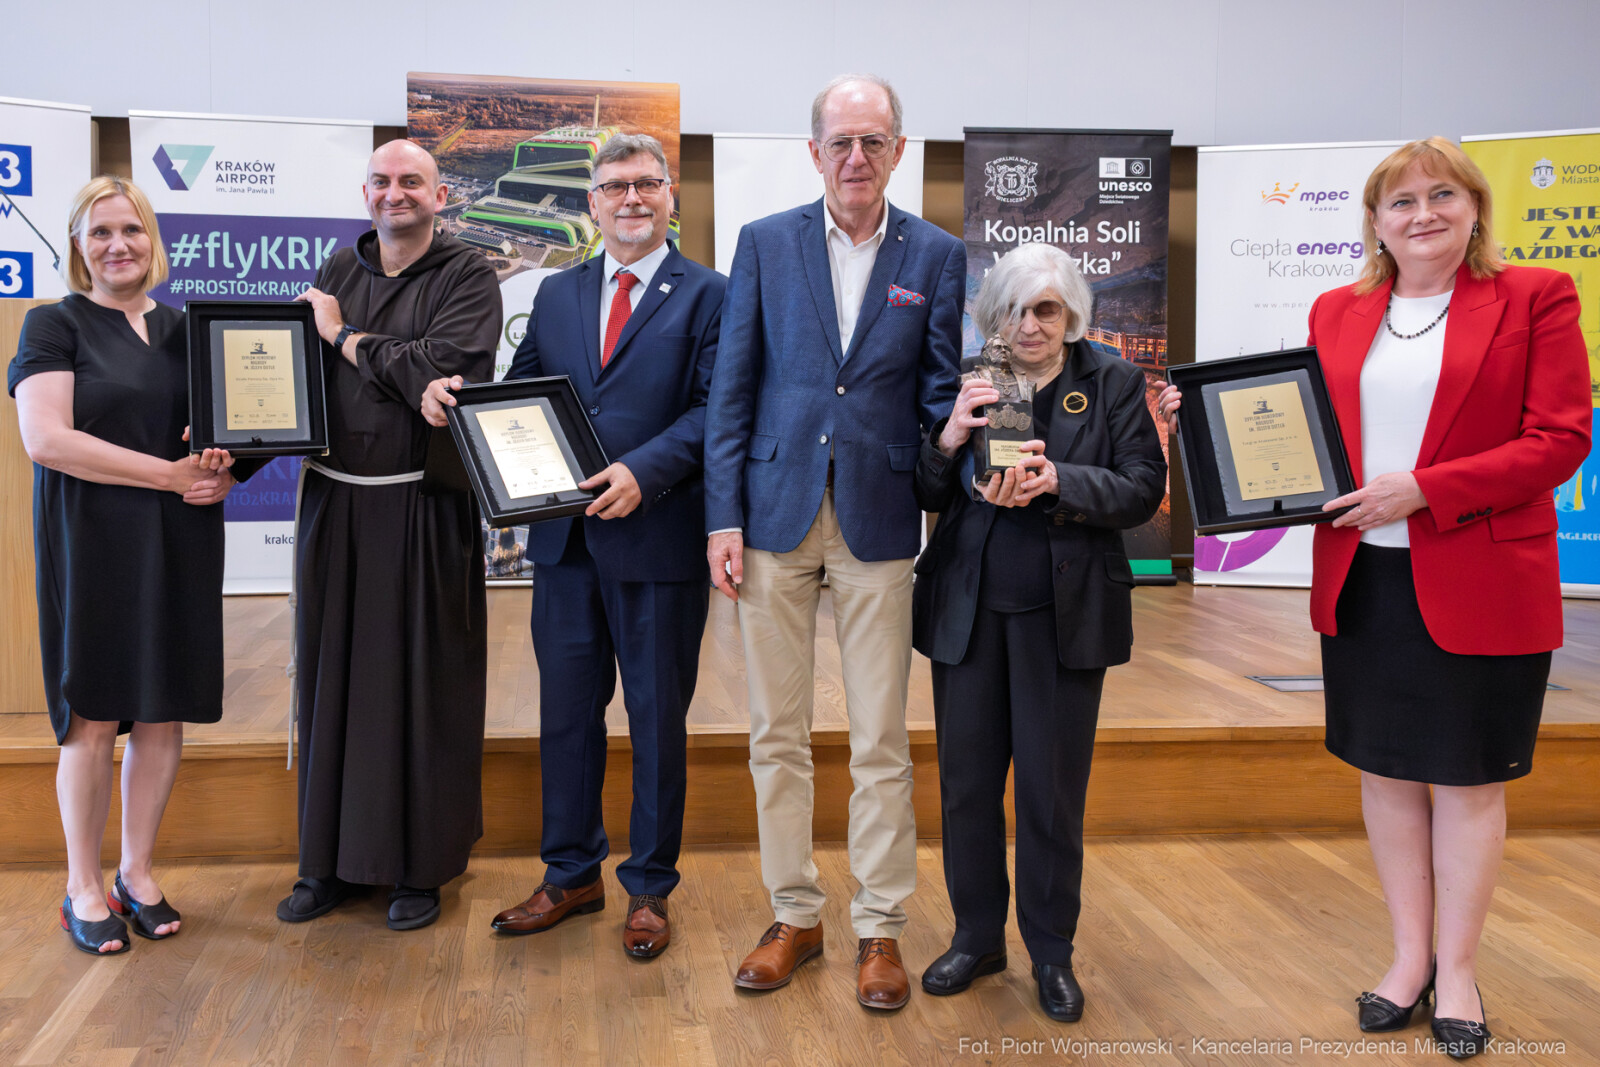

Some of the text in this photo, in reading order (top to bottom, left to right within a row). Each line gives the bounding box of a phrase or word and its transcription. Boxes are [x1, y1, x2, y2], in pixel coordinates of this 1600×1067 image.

[215, 160, 276, 173] KRAKÓW
[1562, 164, 1600, 175] WOD
[215, 173, 276, 185] AIRPORT
[1099, 181, 1152, 192] unesco
[1562, 175, 1600, 185] Miasta
[1299, 190, 1350, 205] mpec
[985, 219, 1141, 246] Kopalnia Soli
[1539, 226, 1556, 240] Z
[169, 231, 338, 279] #flyKRK
[1230, 238, 1364, 260] Ciepła energ
[1498, 242, 1600, 260] KAŻDEG
[1268, 259, 1354, 278] Krakowa
[170, 279, 315, 295] #PROSTOzKRAKO
